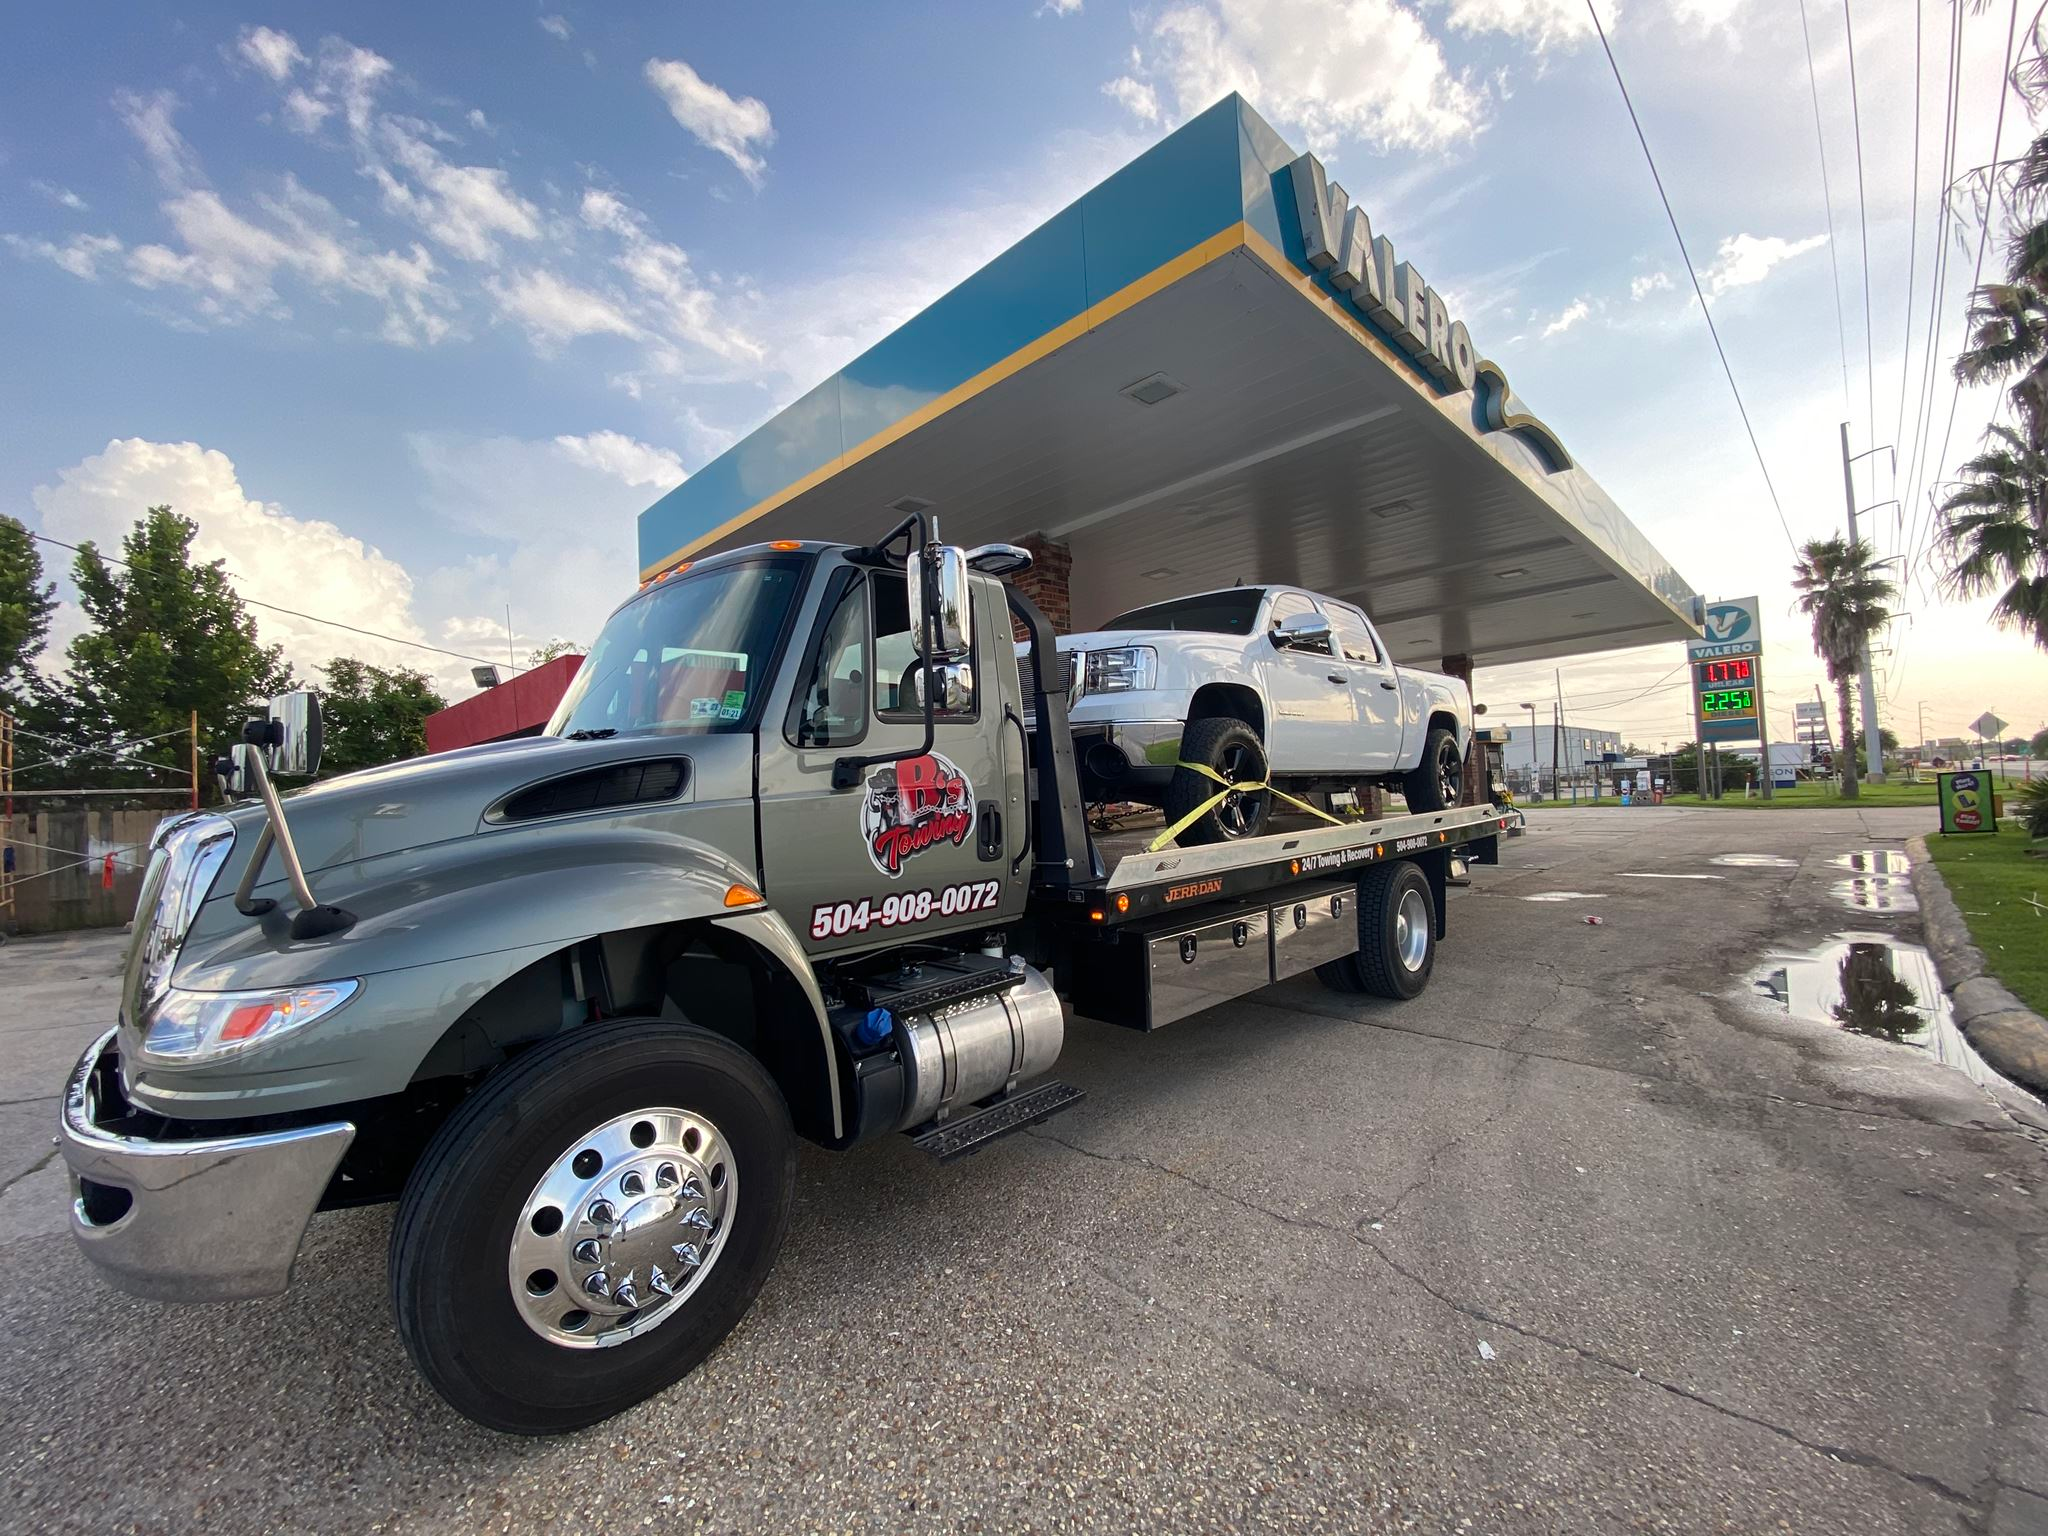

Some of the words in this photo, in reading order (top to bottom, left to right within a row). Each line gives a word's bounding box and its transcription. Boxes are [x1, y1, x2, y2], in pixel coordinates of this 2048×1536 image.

[1290, 151, 1476, 390] VALERO
[1695, 643, 1753, 658] VALERO
[1704, 691, 1742, 711] 2.25
[875, 812, 971, 870] Towing
[1302, 857, 1317, 872] 24/7
[1317, 852, 1341, 868] Towing
[1340, 852, 1347, 863] &
[1346, 847, 1374, 861] Recovery
[812, 881, 999, 938] 504-908-0072
